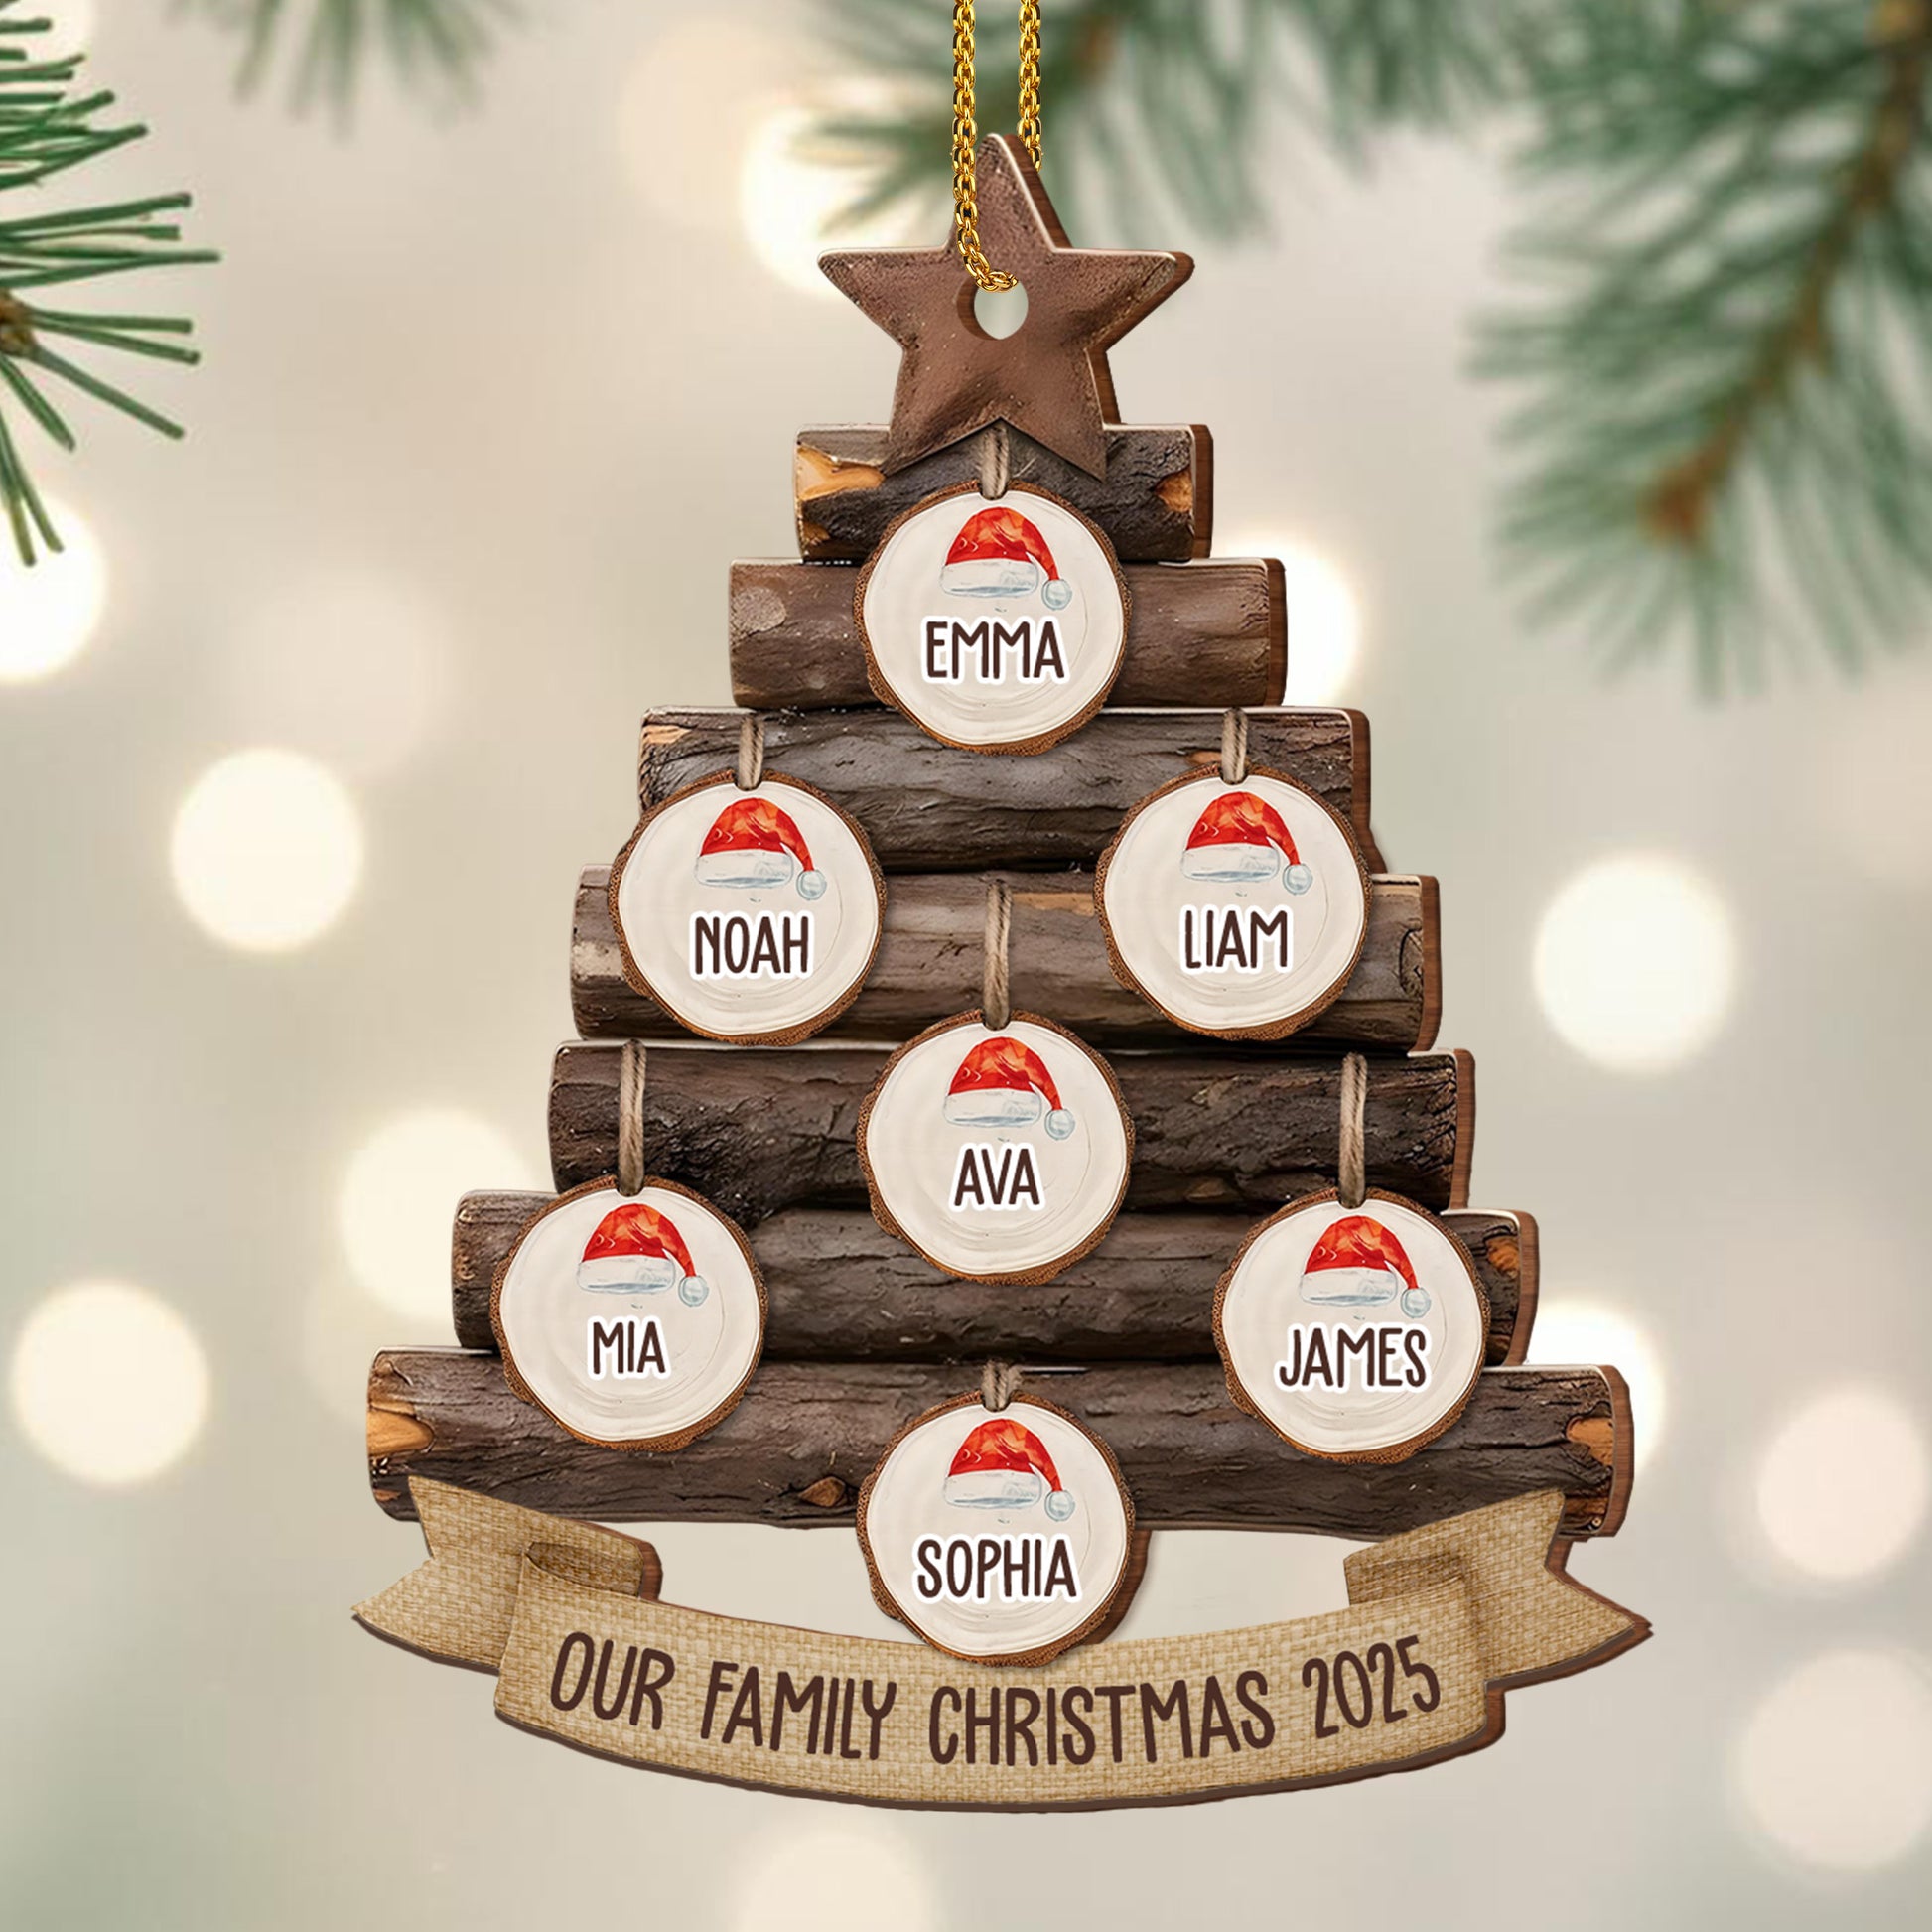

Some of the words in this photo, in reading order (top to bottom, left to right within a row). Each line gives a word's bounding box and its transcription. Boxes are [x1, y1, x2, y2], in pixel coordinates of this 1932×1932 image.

[927, 621, 1064, 678] EMMA
[696, 917, 808, 974] NOAH
[1186, 911, 1287, 968] LIAM
[955, 1149, 1039, 1205] AVA
[594, 1321, 665, 1374] MIA
[1280, 1328, 1425, 1387] JAMES
[918, 1540, 1076, 1598] SOPHIA
[551, 1632, 675, 1731] OUR
[701, 1661, 897, 1760] FAMILY
[929, 1671, 1275, 1766] CHRISTMAS
[1303, 1635, 1440, 1739] 2025
